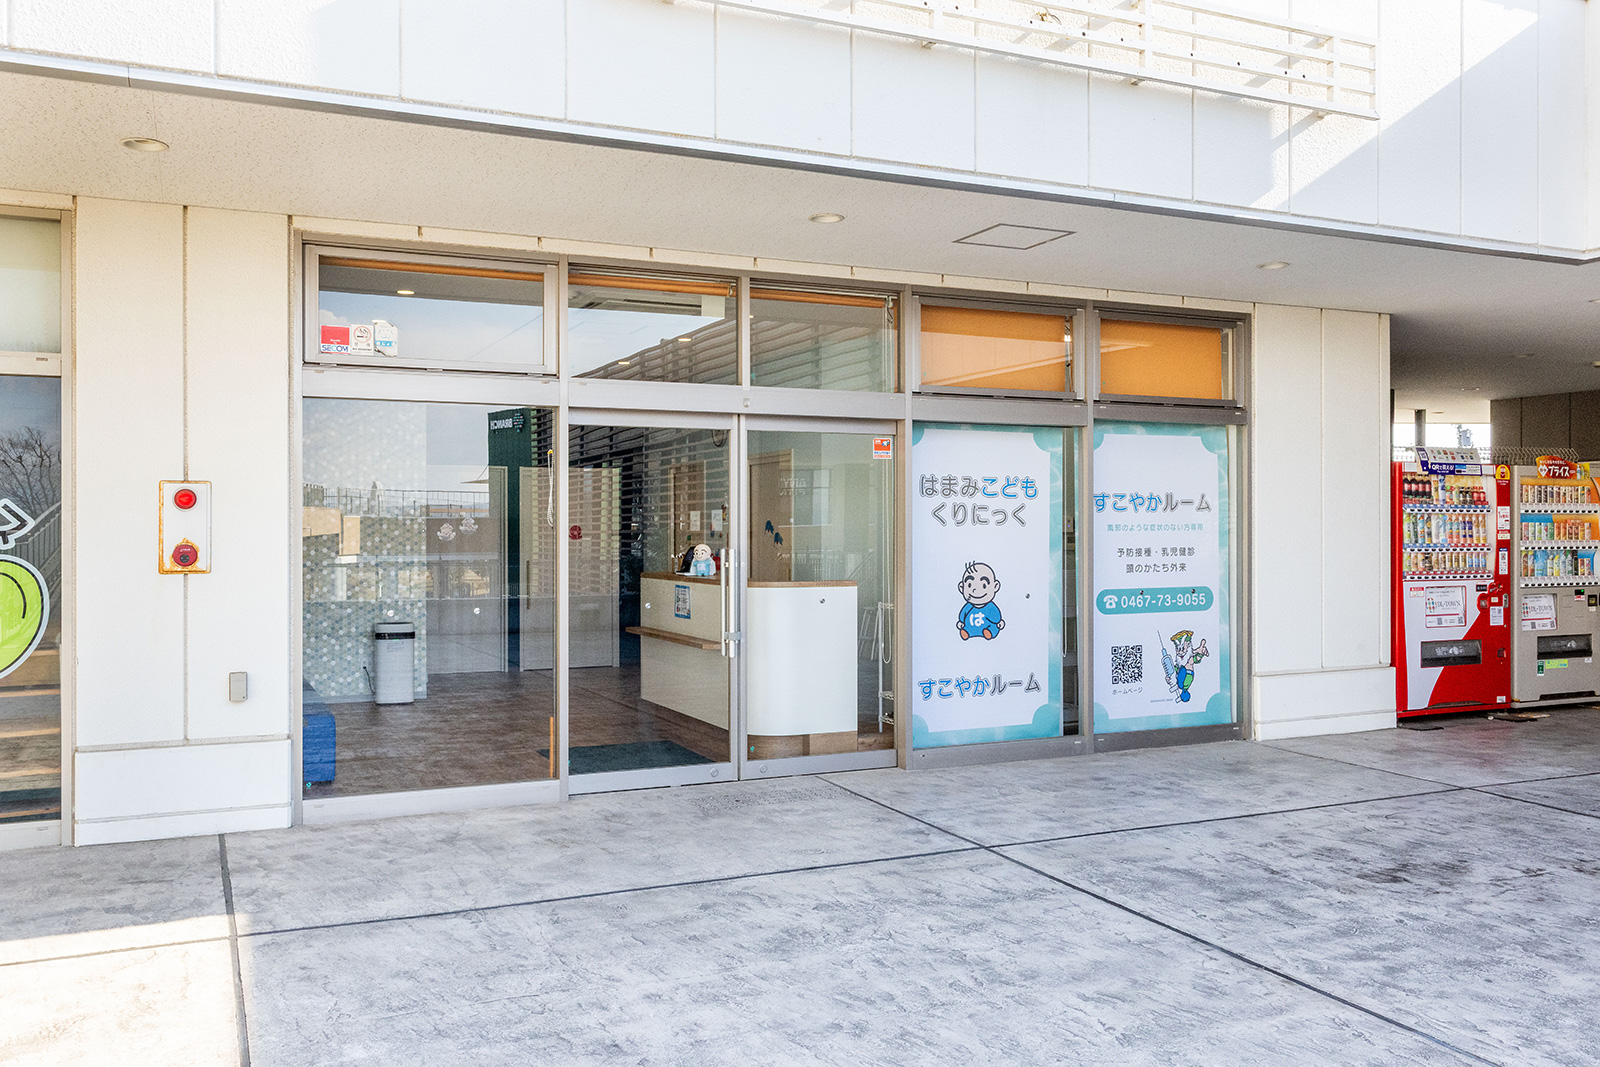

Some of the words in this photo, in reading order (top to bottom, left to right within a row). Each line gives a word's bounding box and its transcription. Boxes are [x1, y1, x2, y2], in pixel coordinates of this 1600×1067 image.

[321, 344, 349, 353] SECOM
[1548, 465, 1570, 477] プライス
[919, 473, 1039, 501] はまみこども
[1093, 492, 1211, 514] すこやかルーム
[931, 502, 1026, 527] くりにっく
[1106, 523, 1204, 532] 風邪のような症状のない方専用
[1116, 546, 1196, 558] 予防接種・乳児健診
[1125, 562, 1187, 574] 頭のかたち外来
[1120, 593, 1206, 608] 0467-73-9055
[969, 612, 986, 627] は
[918, 672, 1041, 701] すこやかルーム
[1112, 686, 1143, 695] ホームページ
